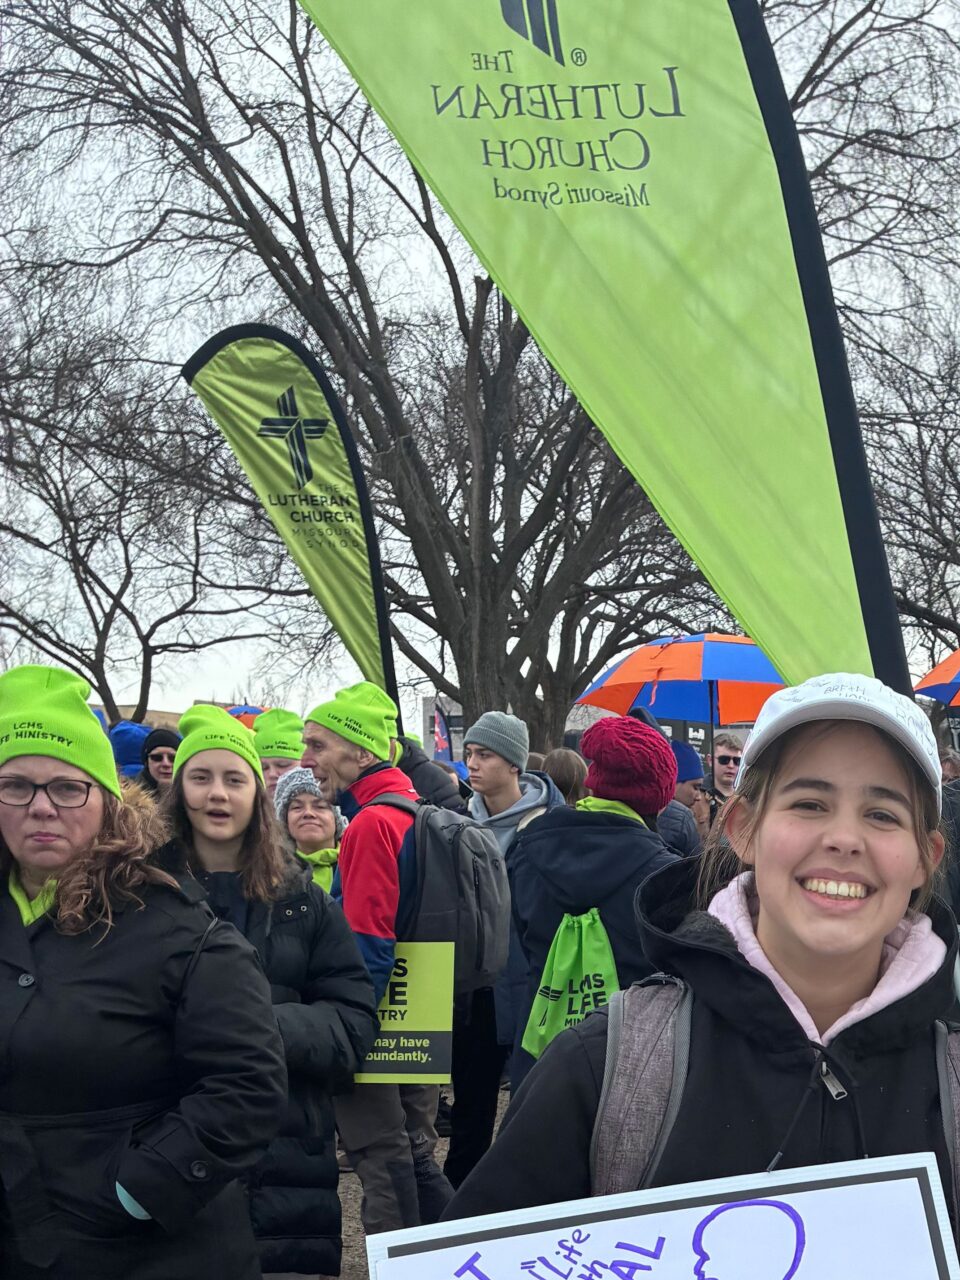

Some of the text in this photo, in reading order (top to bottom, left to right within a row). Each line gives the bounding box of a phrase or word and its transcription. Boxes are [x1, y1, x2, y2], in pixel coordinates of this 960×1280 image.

[268, 494, 351, 506] LUTHERAN
[290, 510, 355, 522] CHURCH
[13, 720, 43, 730] LCMS
[15, 729, 73, 748] MINISTRY
[400, 1036, 430, 1048] have
[537, 1228, 591, 1280] Life
